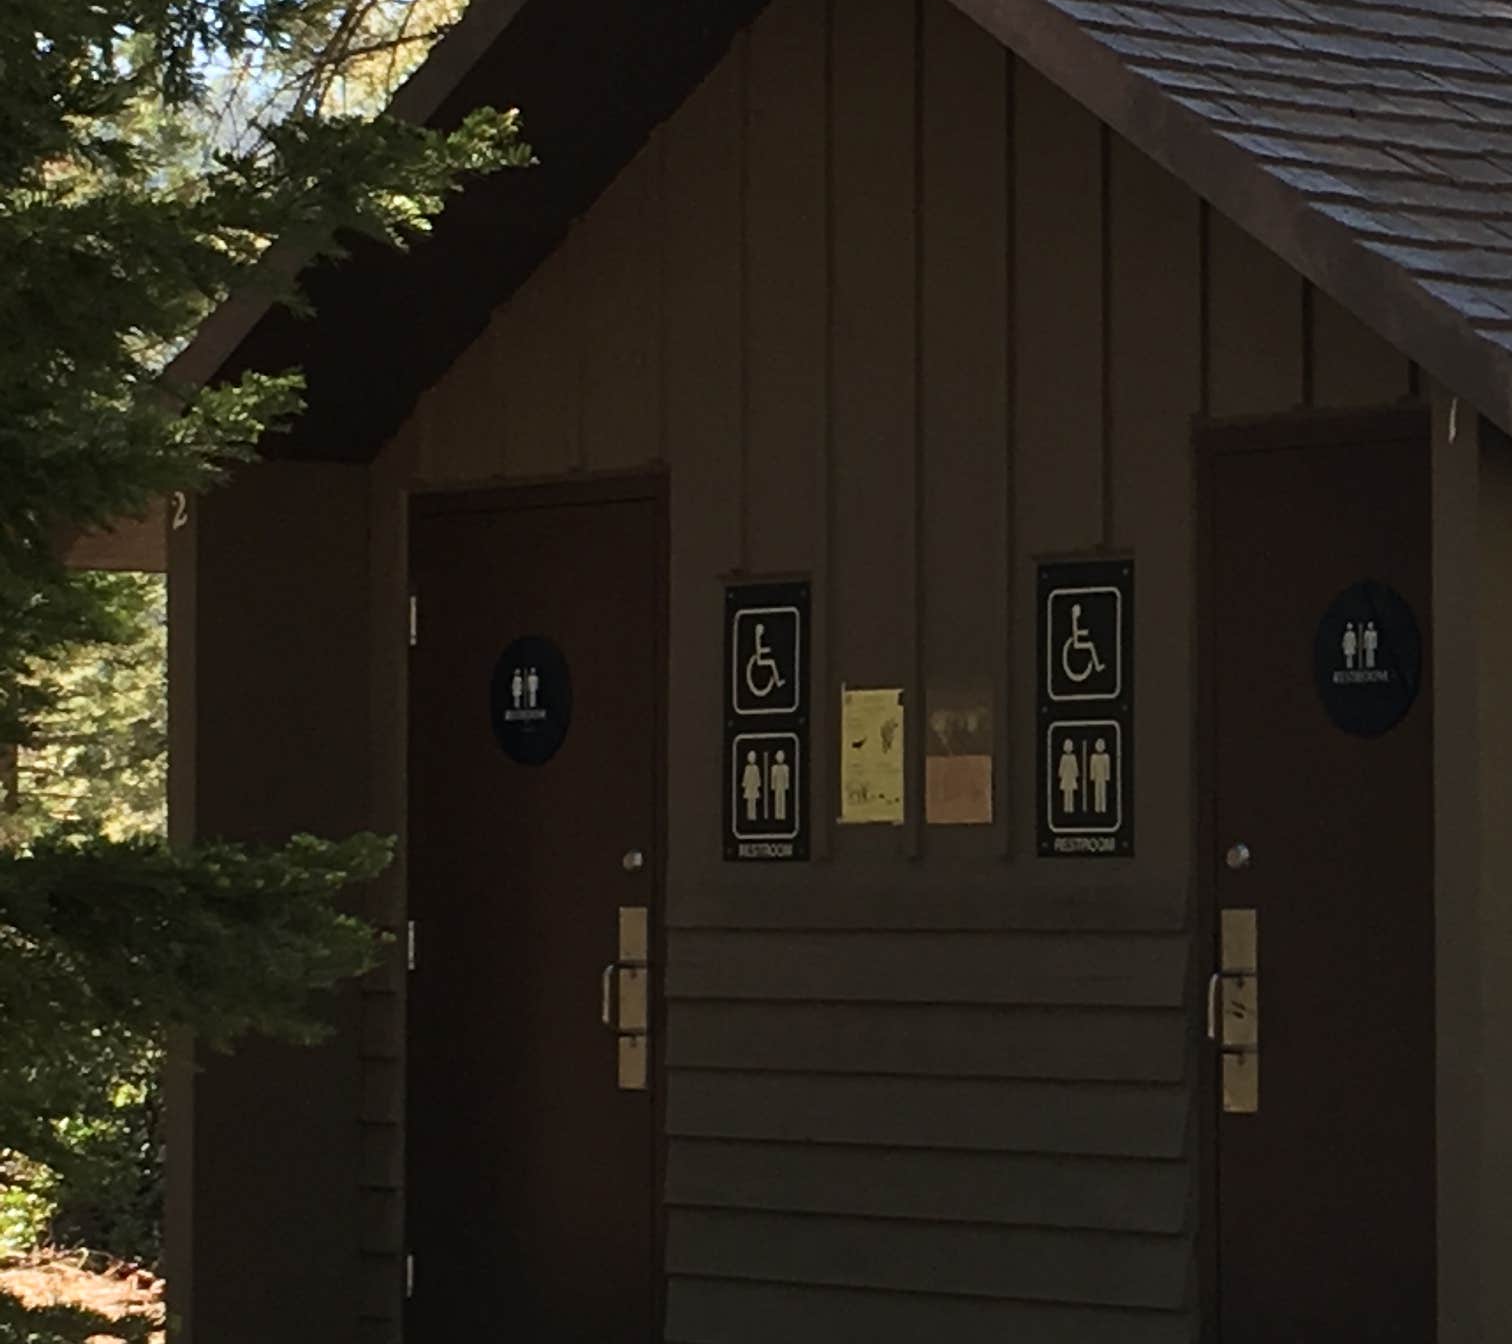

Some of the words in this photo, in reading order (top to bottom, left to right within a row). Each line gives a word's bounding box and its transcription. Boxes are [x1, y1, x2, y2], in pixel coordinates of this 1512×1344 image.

[171, 491, 188, 530] 2
[738, 844, 793, 857] RESTROOM
[1054, 838, 1115, 852] RESTROOM
